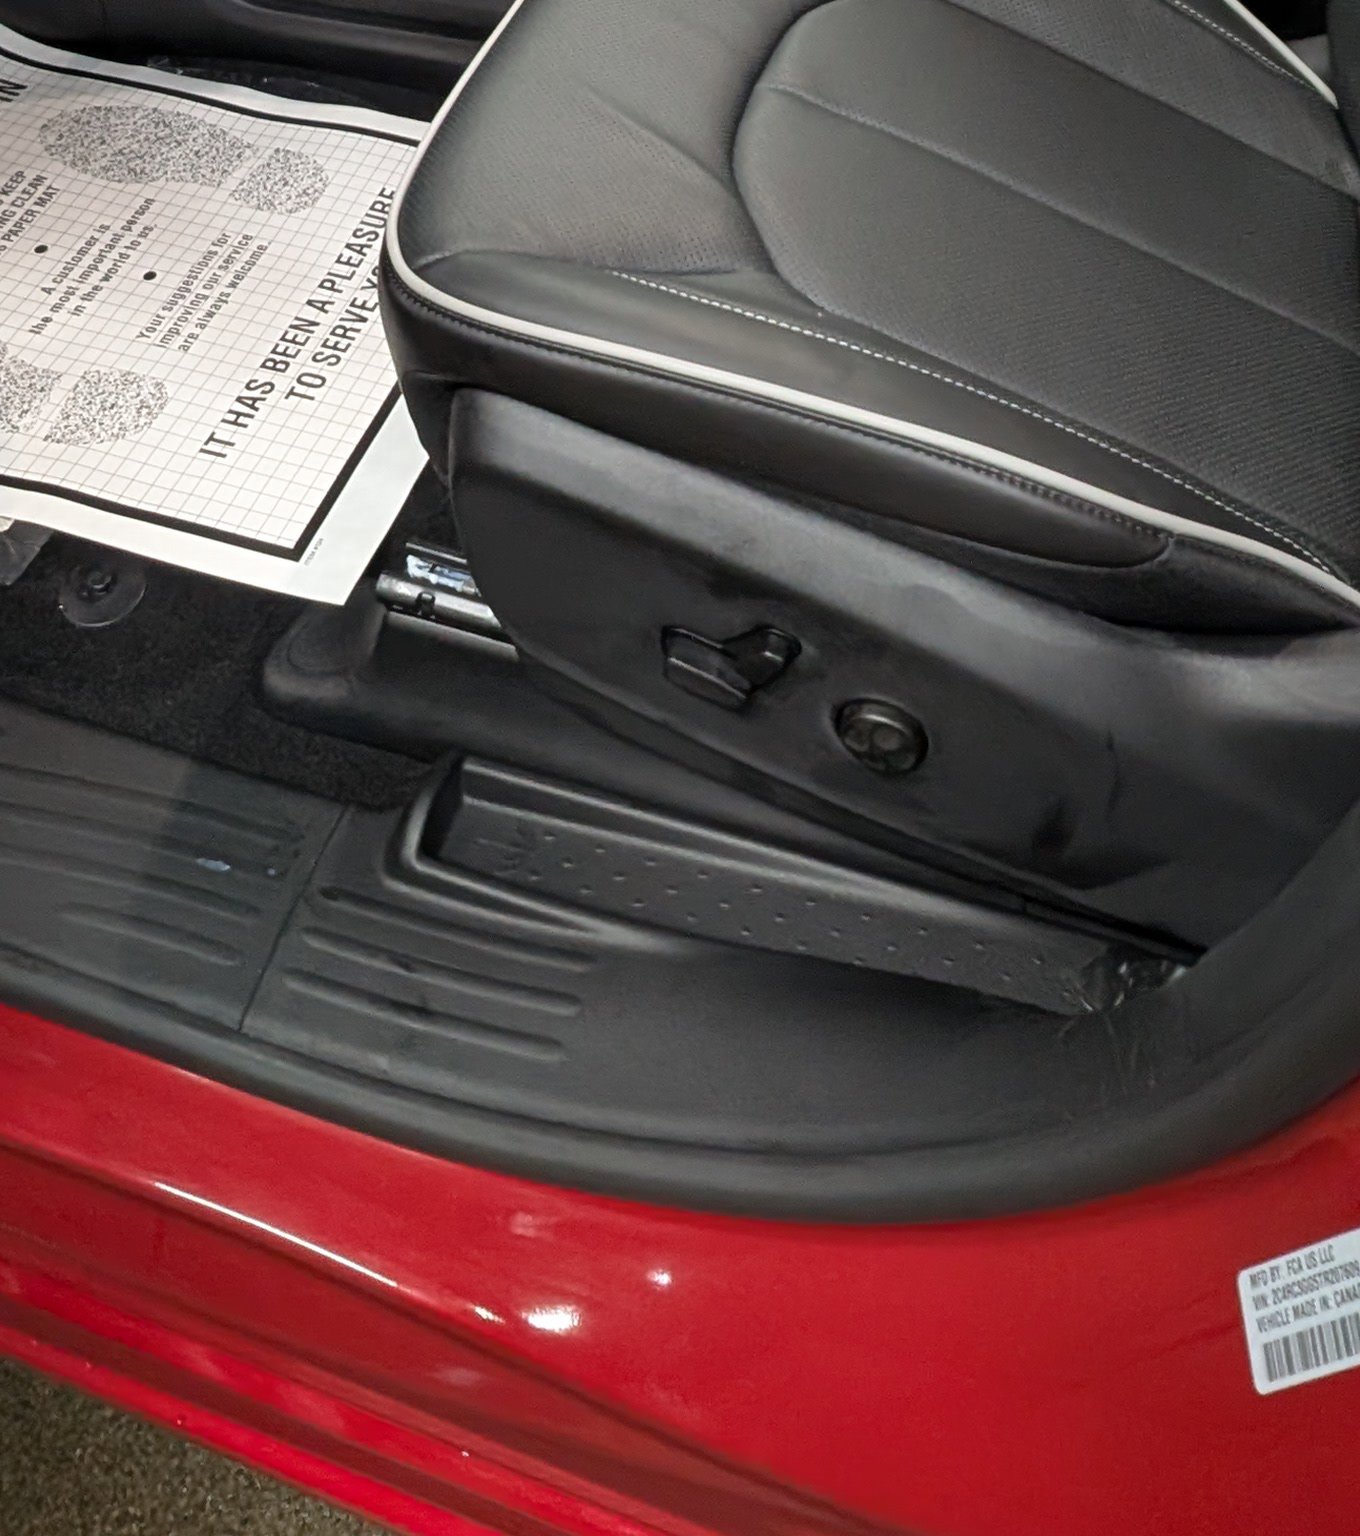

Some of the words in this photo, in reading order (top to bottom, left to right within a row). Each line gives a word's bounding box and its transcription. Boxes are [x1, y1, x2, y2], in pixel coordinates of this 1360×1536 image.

[1, 208, 38, 243] PAPER
[33, 185, 61, 208] MAT
[11, 174, 48, 208] CLEAN
[28, 316, 53, 335] the
[49, 285, 79, 313] most
[73, 233, 124, 284] important
[120, 198, 155, 233] person
[40, 286, 56, 295] A
[52, 235, 99, 284] customer
[93, 224, 111, 234] is
[318, 187, 395, 293] PLEASURE
[68, 304, 86, 317] in
[80, 284, 103, 302] the
[100, 252, 131, 282] world
[124, 239, 141, 251] to
[135, 313, 166, 339] Your
[162, 249, 218, 312] suggestions
[211, 232, 231, 249] for
[153, 292, 209, 349] improving
[203, 272, 221, 290] our
[218, 233, 253, 271] service
[178, 332, 199, 352] are
[195, 291, 231, 330] always
[225, 241, 271, 289] welcome.
[305, 298, 335, 314] A
[260, 316, 320, 373] BEEN
[284, 372, 327, 402] TO
[311, 297, 379, 366] SERVE
[221, 378, 275, 428] HAS
[199, 431, 235, 458] IT
[1249, 1269, 1268, 1289] MFD
[1286, 1256, 1303, 1276] FCA
[1304, 1250, 1318, 1270] US
[1318, 1244, 1335, 1265] LLC
[1256, 1308, 1291, 1333] VEHICLE
[1292, 1298, 1318, 1321] MADE
